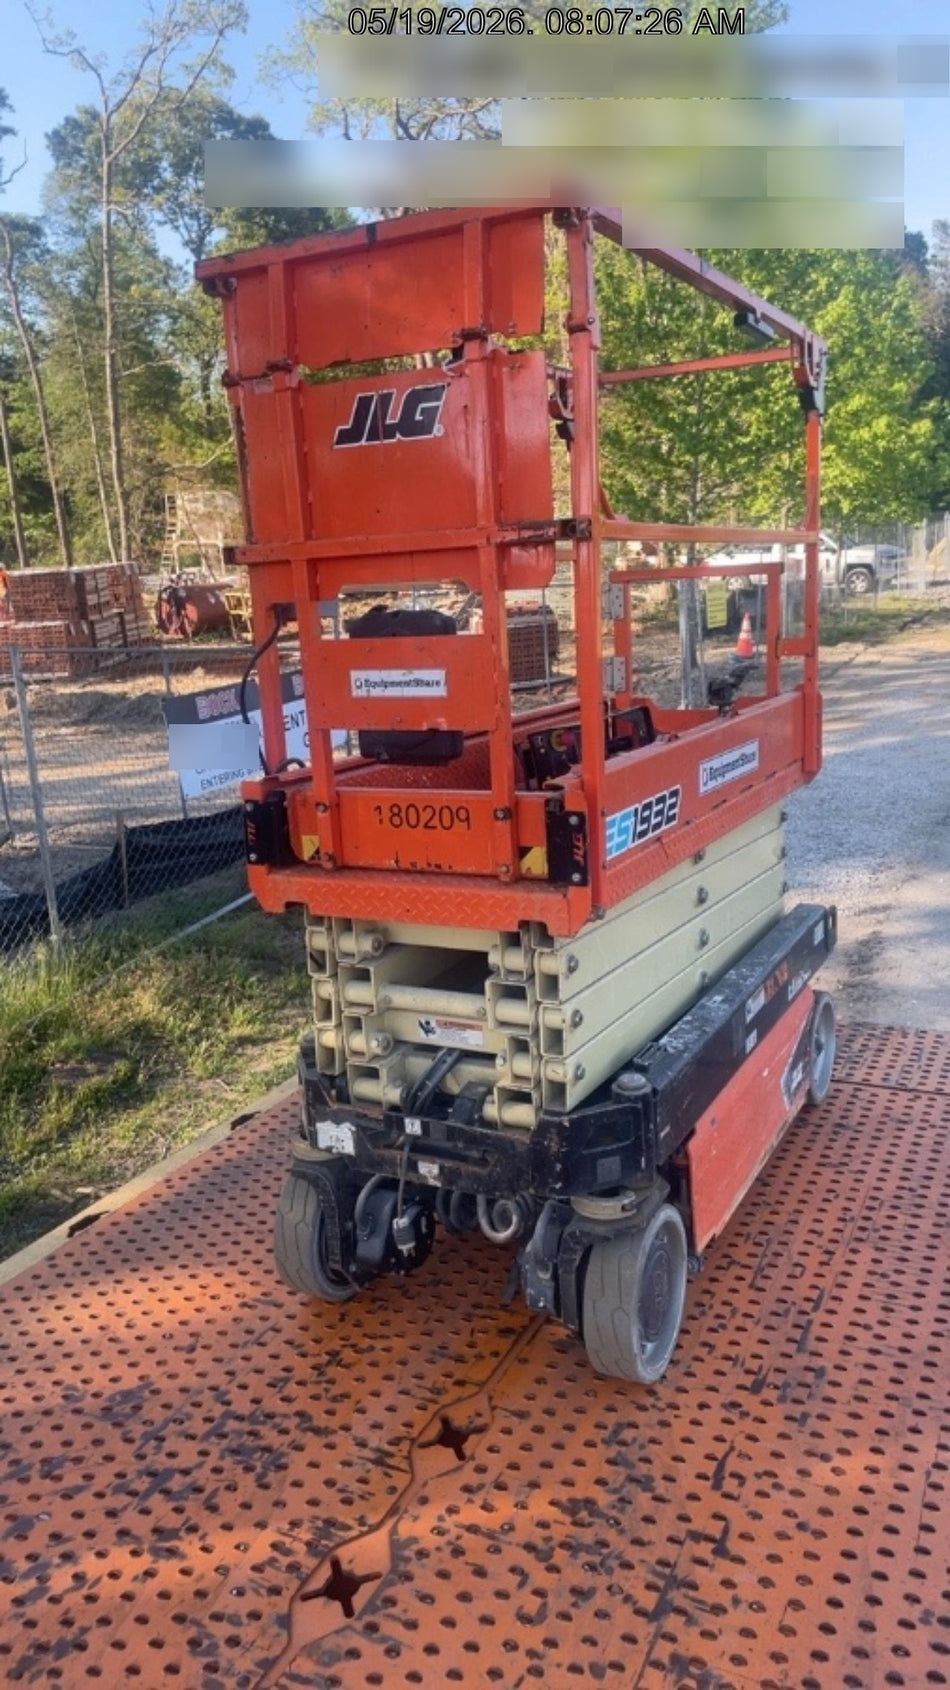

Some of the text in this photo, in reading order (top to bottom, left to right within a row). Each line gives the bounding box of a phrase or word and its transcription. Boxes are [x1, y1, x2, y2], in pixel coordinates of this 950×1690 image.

[332, 383, 448, 448] JLG
[364, 678, 442, 689] EquipmentShare
[200, 768, 245, 791] ENTERING
[709, 751, 757, 781] EquipmentShare
[374, 803, 471, 831] 180209
[606, 787, 681, 858] ES1932
